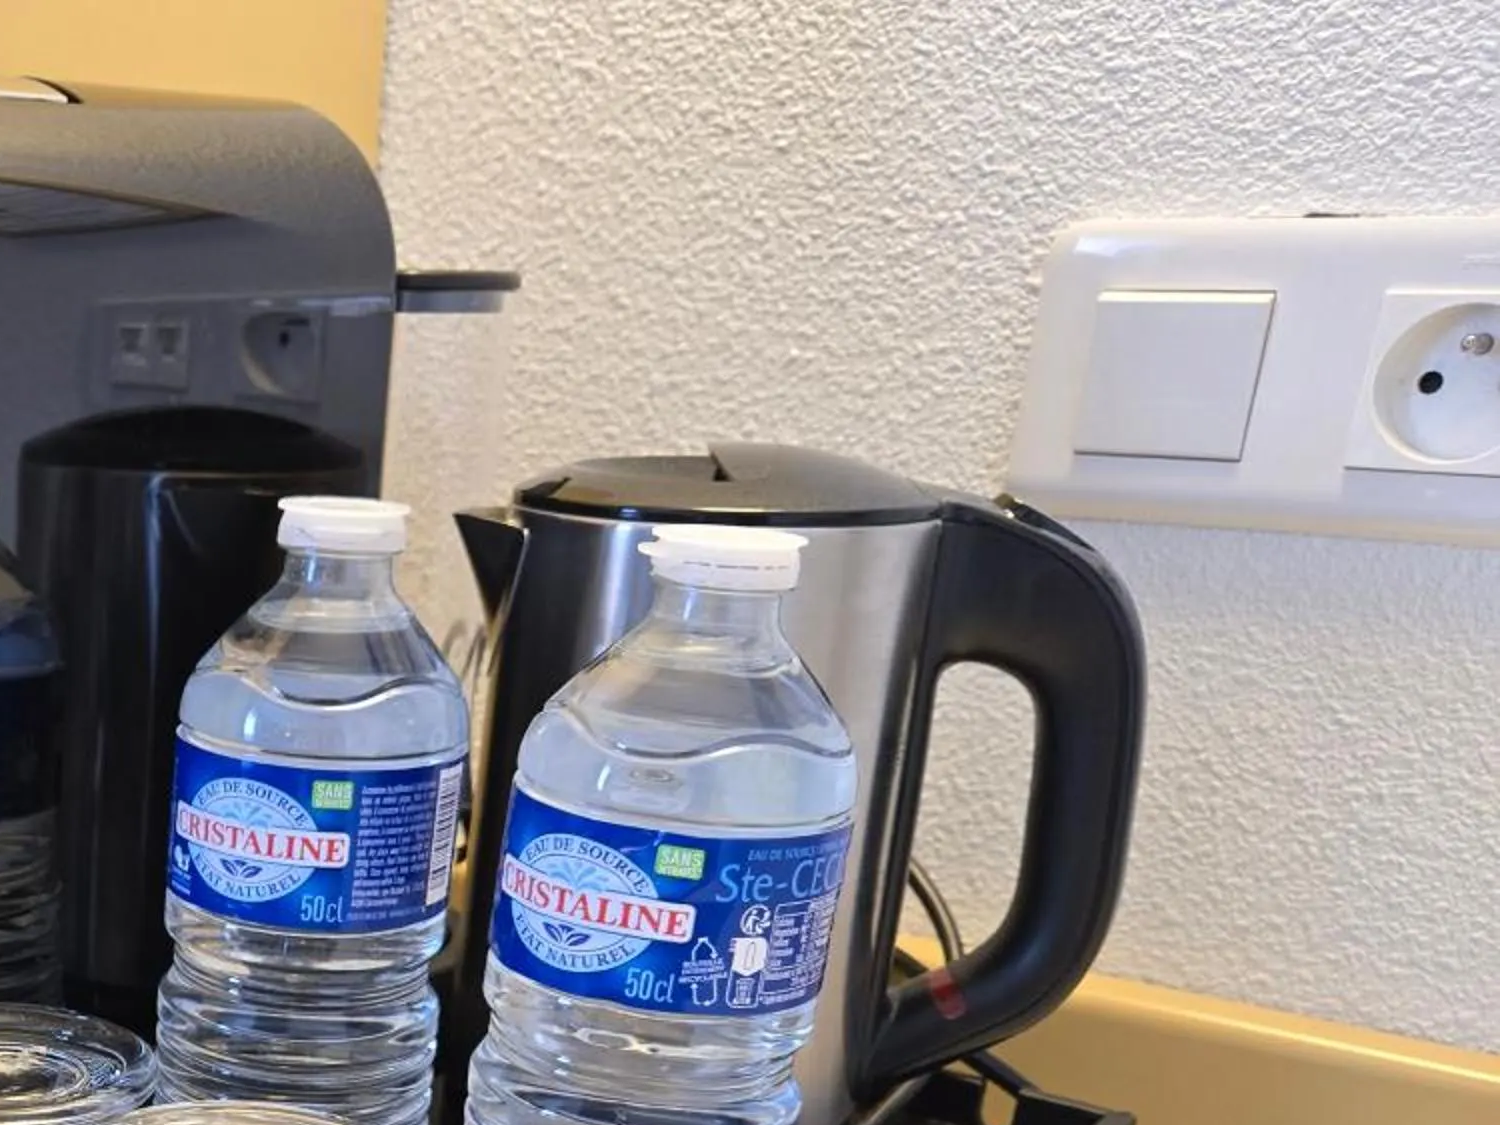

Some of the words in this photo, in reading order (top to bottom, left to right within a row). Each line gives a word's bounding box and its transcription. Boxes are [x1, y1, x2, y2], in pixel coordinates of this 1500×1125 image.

[197, 783, 221, 805] EAU
[222, 781, 242, 793] DE
[245, 782, 309, 829] SOURCE
[179, 808, 346, 864] CRISTALINE
[225, 873, 302, 897] NATUREL
[525, 836, 548, 861] EAU
[553, 837, 574, 850] DE
[578, 838, 649, 893] SOURCE
[301, 896, 343, 922] 50cl
[505, 862, 691, 938] CRISTALINE
[547, 943, 634, 969] NATUREL
[624, 967, 676, 1005] 50cl
